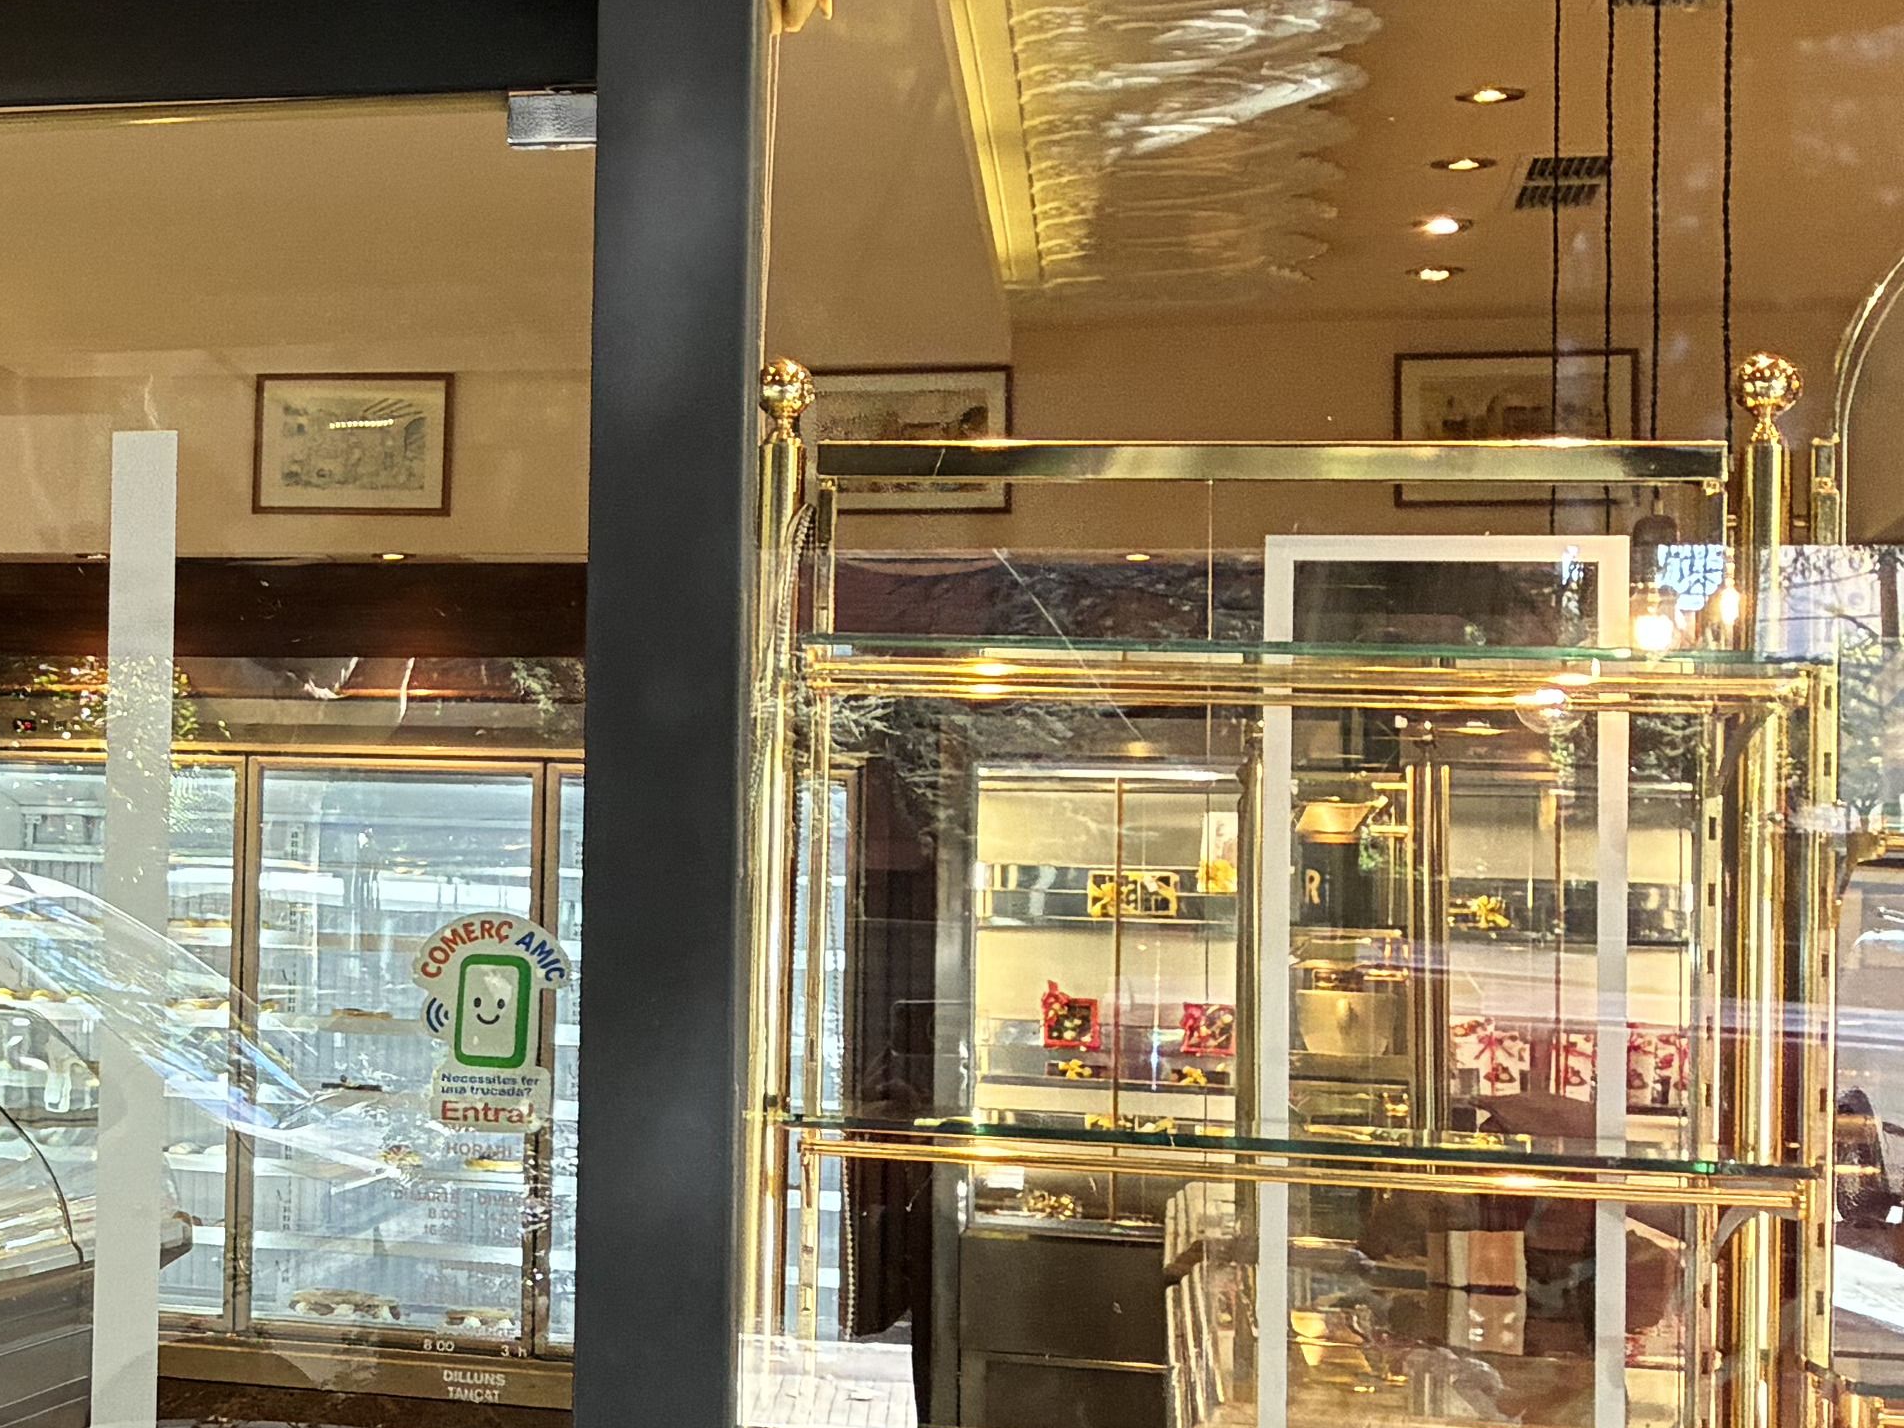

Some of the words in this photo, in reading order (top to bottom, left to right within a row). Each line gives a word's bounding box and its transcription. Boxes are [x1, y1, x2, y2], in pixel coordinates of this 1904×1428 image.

[420, 919, 513, 979] COMERÇ
[514, 930, 566, 983] AMIC
[441, 1072, 518, 1086] Necessites
[521, 1072, 540, 1086] fer
[441, 1085, 467, 1096] una
[470, 1085, 533, 1098] trucada?
[441, 1100, 535, 1124] Entra!
[442, 1369, 506, 1387] DILLUNS
[447, 1386, 501, 1404] TANCAT
